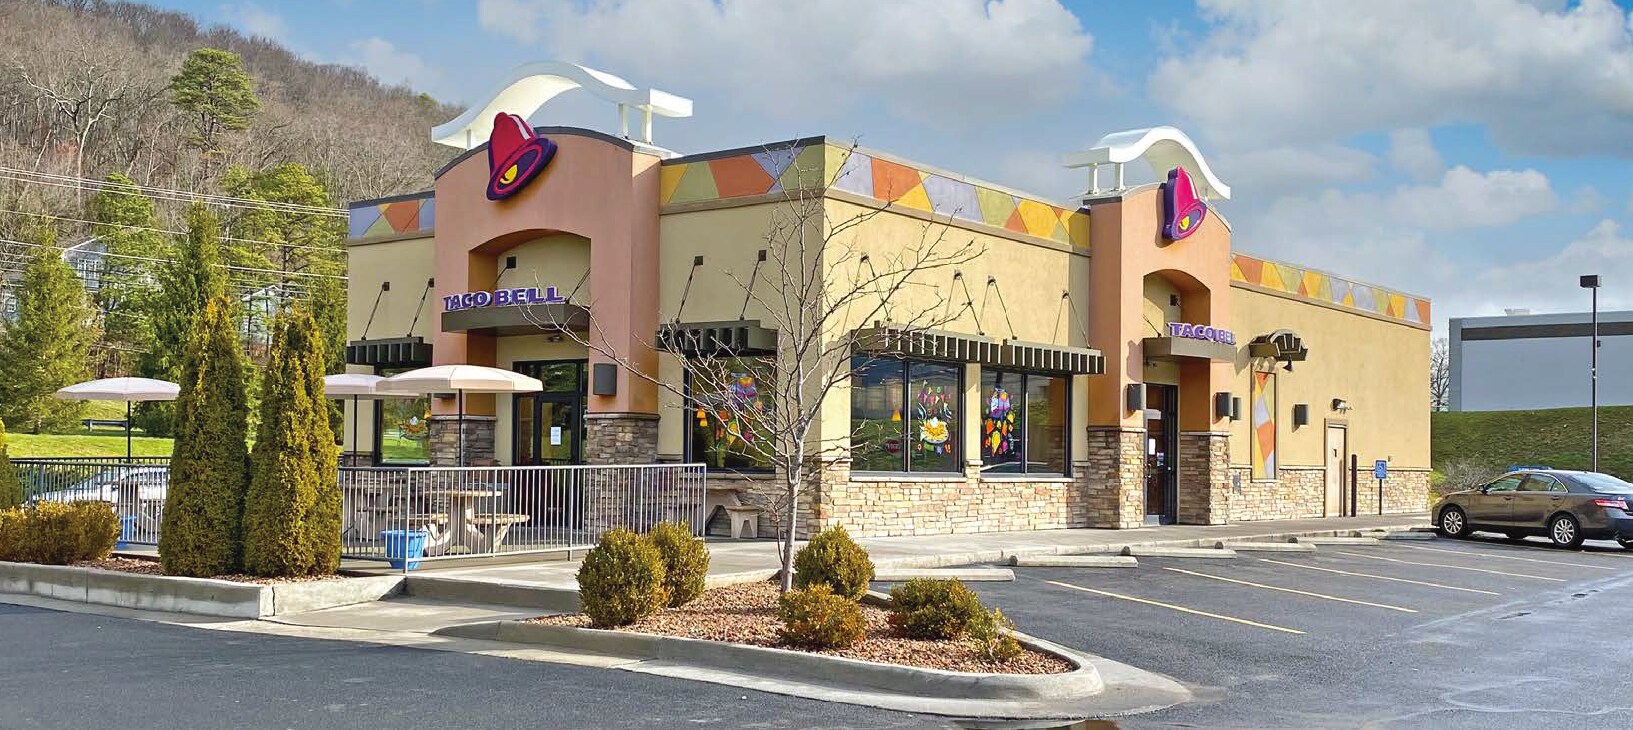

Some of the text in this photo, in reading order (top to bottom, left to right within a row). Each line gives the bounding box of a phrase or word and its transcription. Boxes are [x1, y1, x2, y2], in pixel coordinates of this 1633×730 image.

[443, 286, 565, 311] TACO BELL
[1168, 323, 1216, 341] TACO
